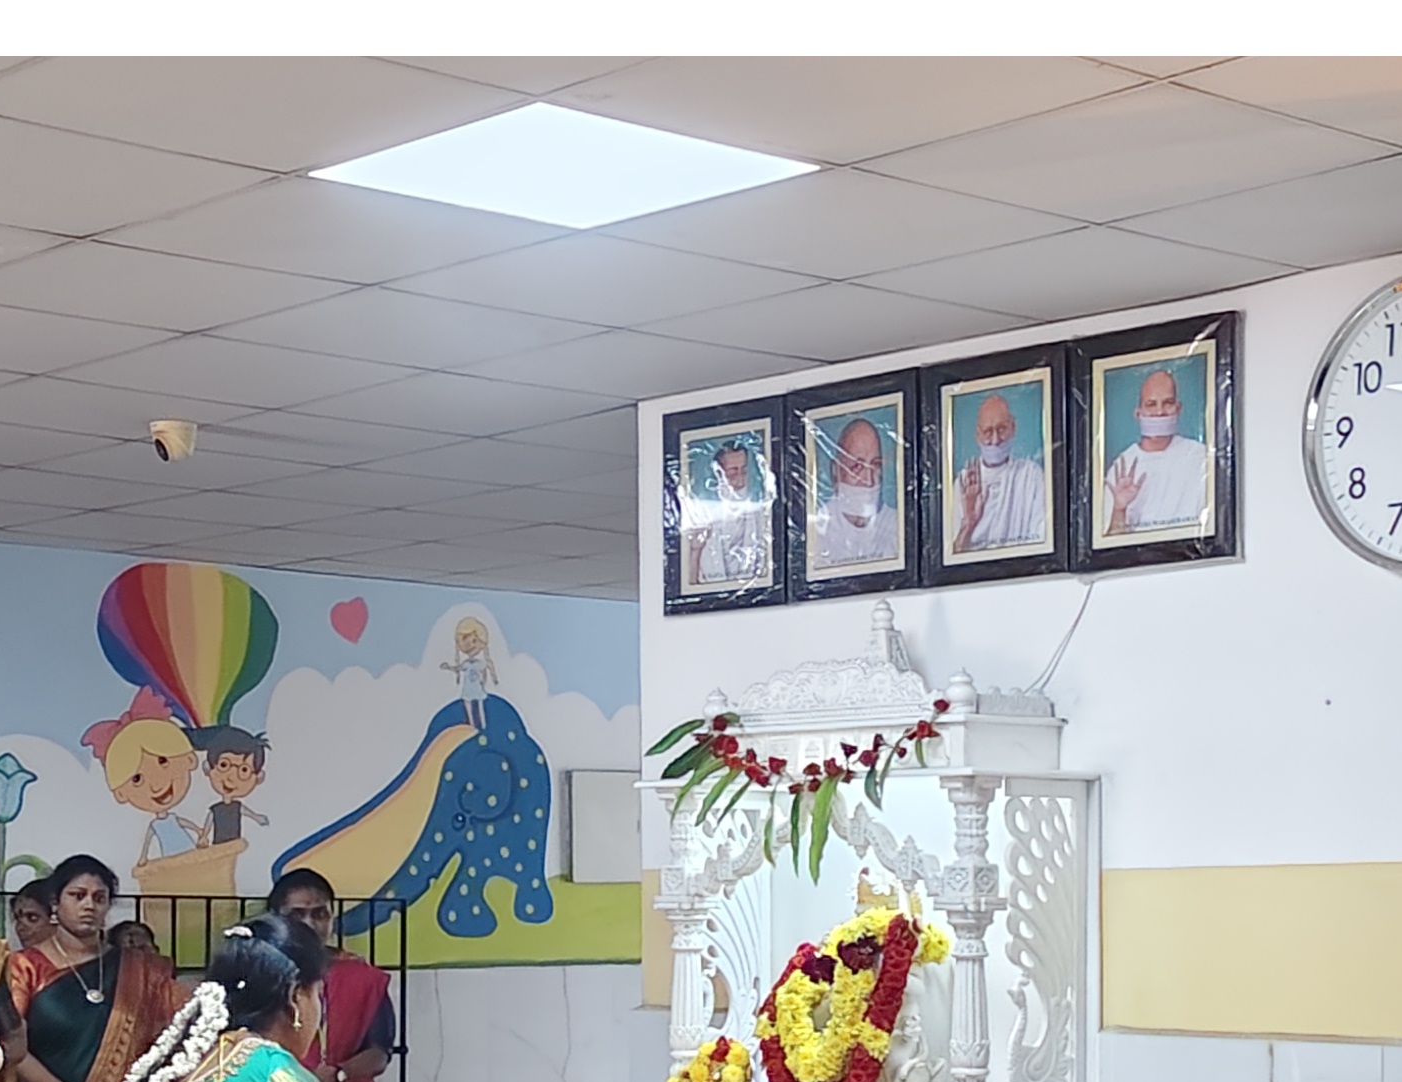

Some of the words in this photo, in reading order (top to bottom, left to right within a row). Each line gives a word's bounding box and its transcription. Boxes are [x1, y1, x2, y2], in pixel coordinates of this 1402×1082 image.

[1353, 360, 1382, 395] 10
[1336, 416, 1354, 449] 9
[1348, 467, 1366, 500] 8
